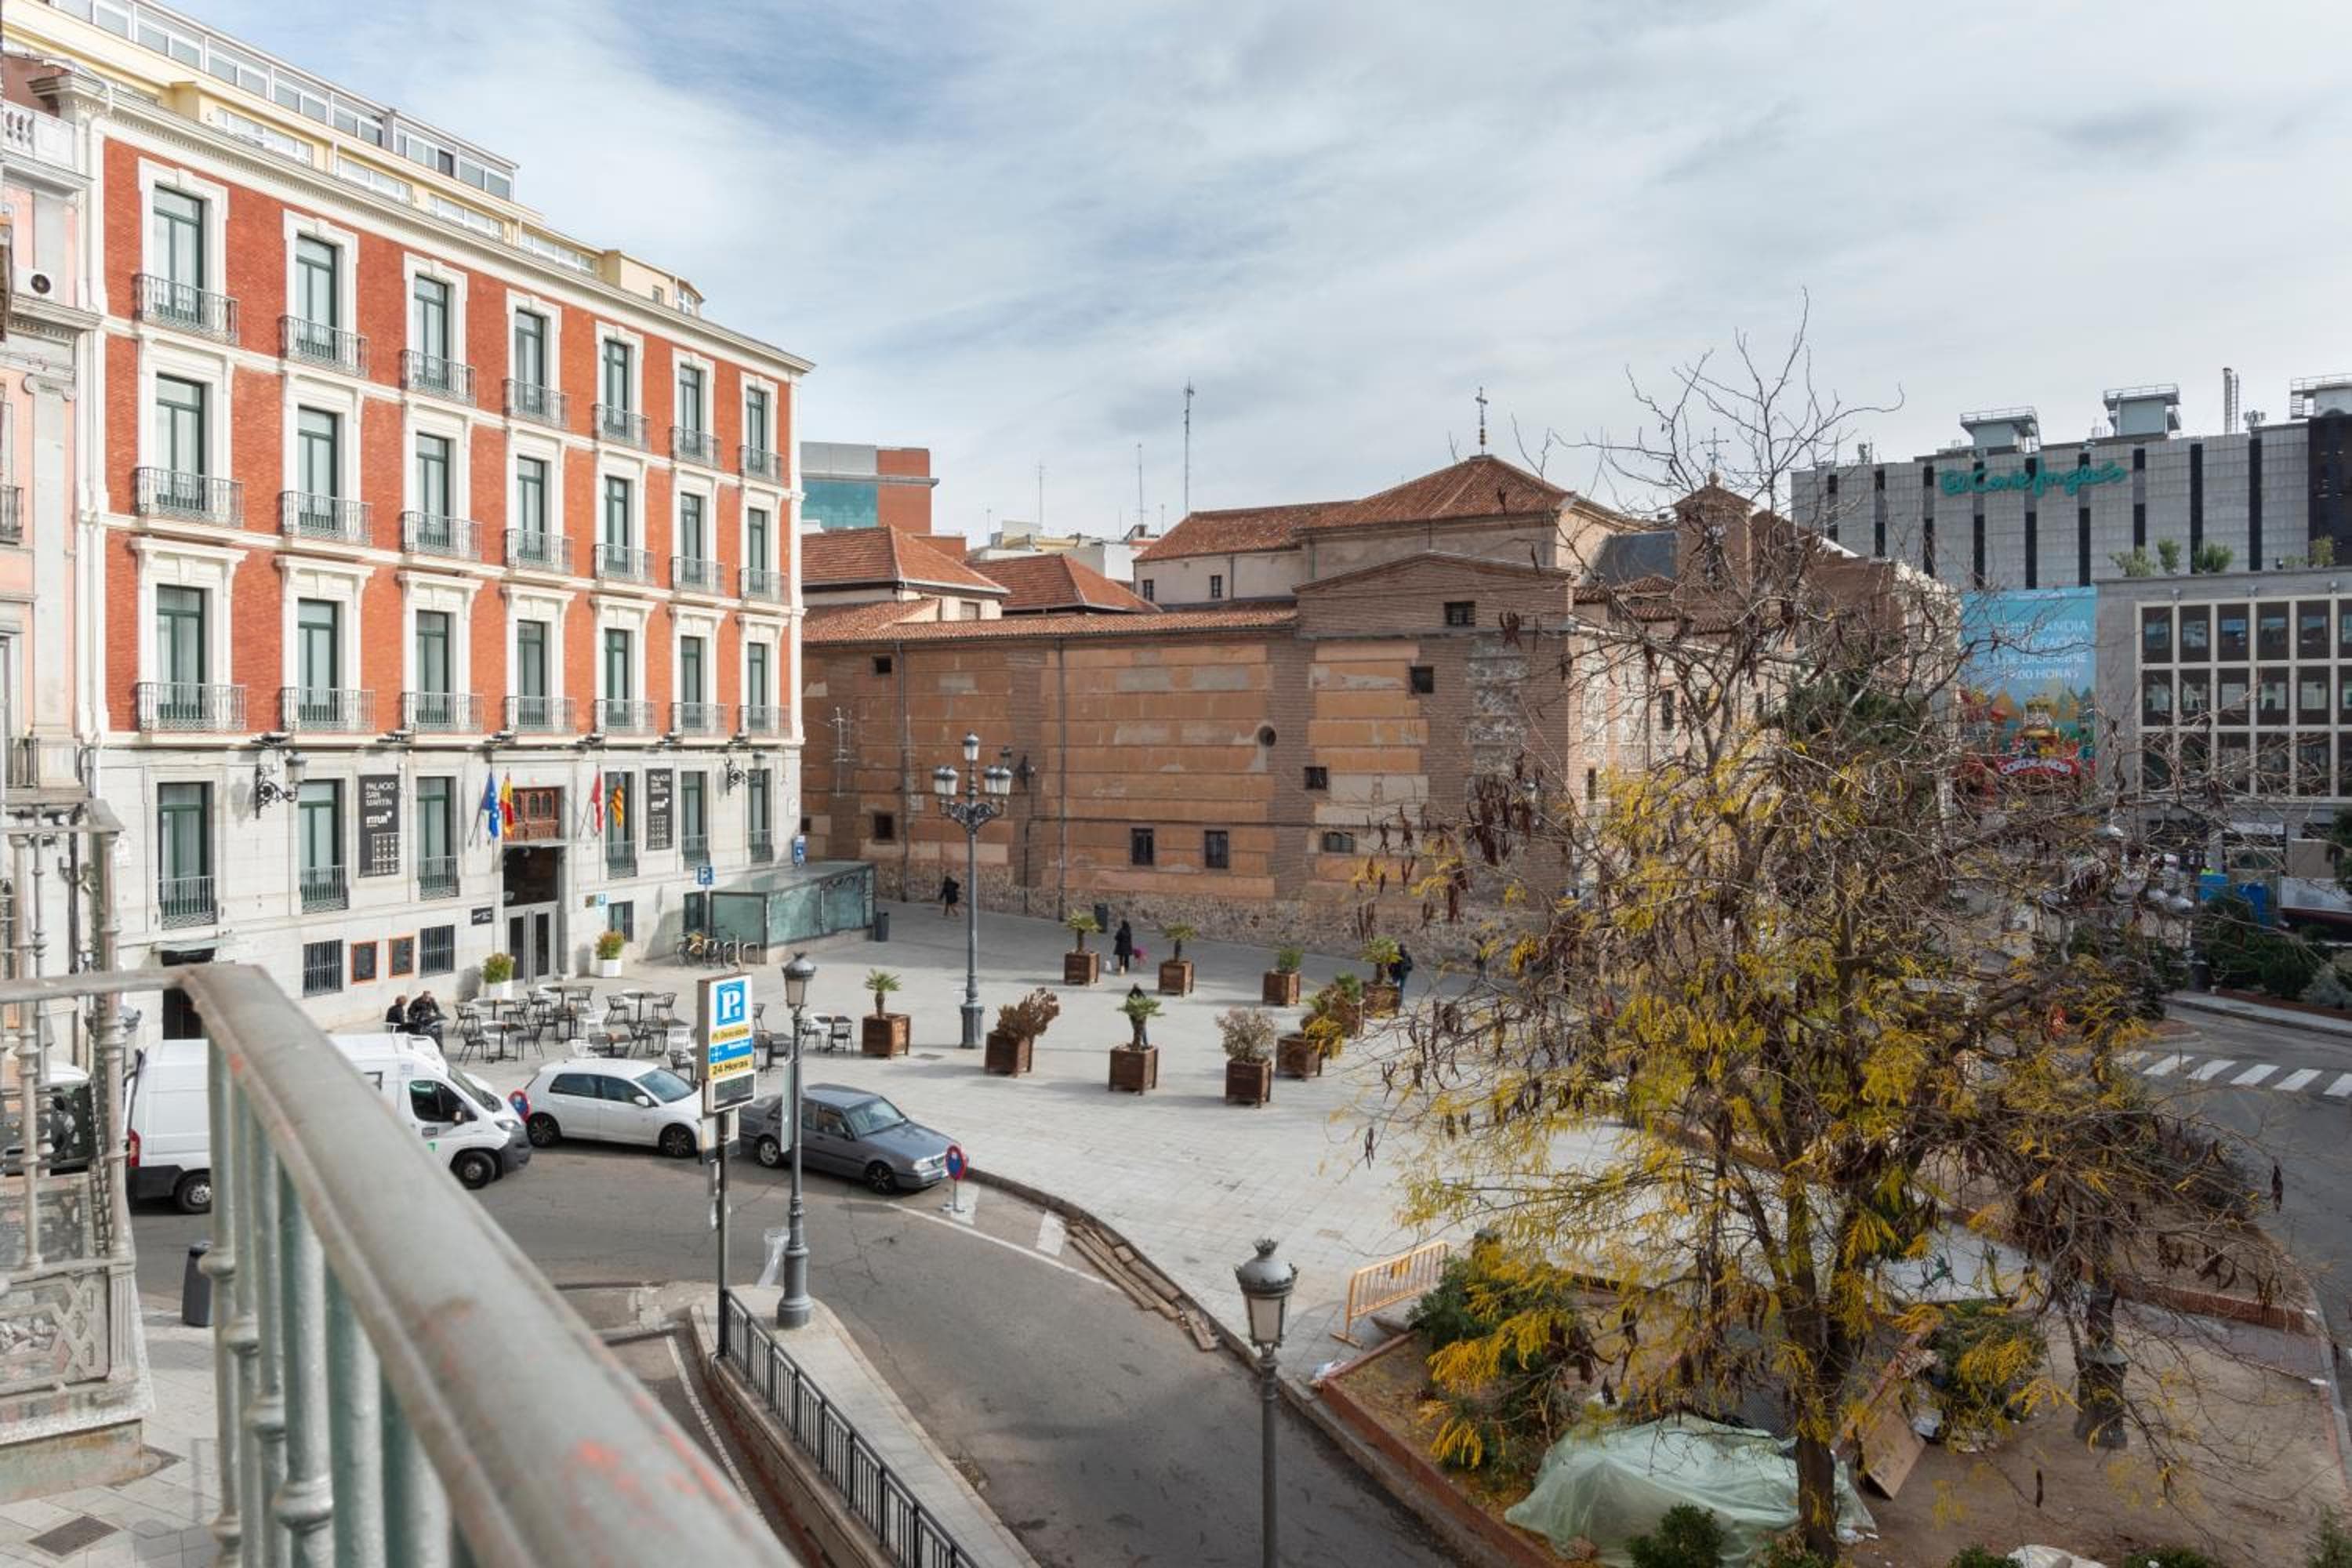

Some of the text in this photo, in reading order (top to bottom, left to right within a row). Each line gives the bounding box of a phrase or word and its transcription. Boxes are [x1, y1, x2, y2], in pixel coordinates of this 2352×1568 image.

[1940, 470, 1966, 496] El
[1969, 468, 2031, 494] Corte
[365, 782, 396, 791] PALACIO
[712, 1060, 749, 1076] 24 Horas
